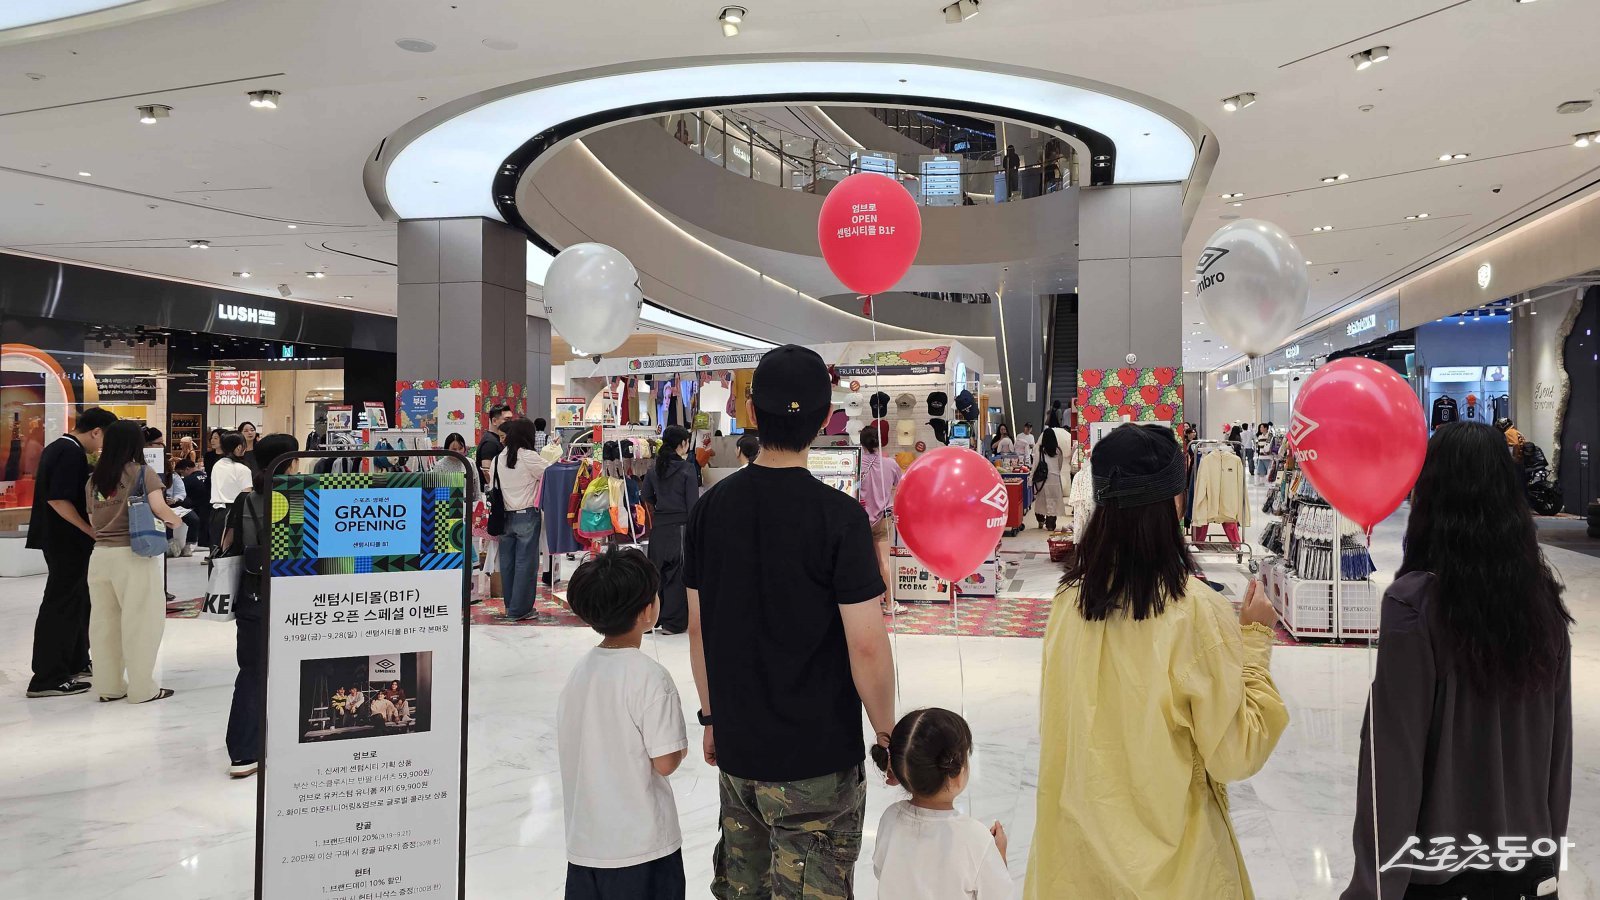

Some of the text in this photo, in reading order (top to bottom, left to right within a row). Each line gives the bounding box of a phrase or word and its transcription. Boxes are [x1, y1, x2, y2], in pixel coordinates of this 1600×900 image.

[852, 203, 877, 214] 엄브로
[852, 214, 878, 224] OPEN
[837, 225, 896, 239] 센텀시티몰 B1F
[1197, 271, 1225, 296] mbro
[218, 303, 258, 323] LUSH
[214, 394, 257, 404] ORIGINAL
[1442, 409, 1450, 421] 8
[334, 504, 407, 520] GRAND
[334, 520, 406, 532] OPENING
[312, 588, 420, 608] 센텀시티몰(B1F)
[284, 604, 449, 626] 새단장 오픈 스페셜 이벤트
[365, 628, 401, 638] 센텀시티몰
[404, 627, 417, 635] B1F
[418, 626, 426, 634] 각
[353, 750, 378, 761] 엄브로
[324, 766, 348, 776] 신세계
[350, 762, 379, 774] 센텀시티
[398, 759, 412, 768] 상품
[298, 792, 322, 803] 엄브로
[380, 785, 394, 794] 저지
[396, 780, 428, 792] 69,900원
[286, 806, 308, 816] 화이트
[386, 796, 408, 807] 글로벌
[410, 793, 432, 804] 콜라보
[434, 790, 448, 800] 상품
[355, 821, 372, 831] 캉골
[314, 840, 321, 848] 1.
[322, 835, 360, 847] 브랜드데이
[282, 856, 289, 864] 2.
[290, 852, 316, 864] 20만원
[318, 850, 333, 860] 이상
[335, 849, 350, 858] 구매
[351, 847, 360, 856] 시
[378, 842, 400, 853] 파우치
[354, 867, 372, 878] 헌터
[330, 881, 368, 893] 브랜드데이
[370, 878, 386, 888] 10%
[388, 876, 402, 885] 할인
